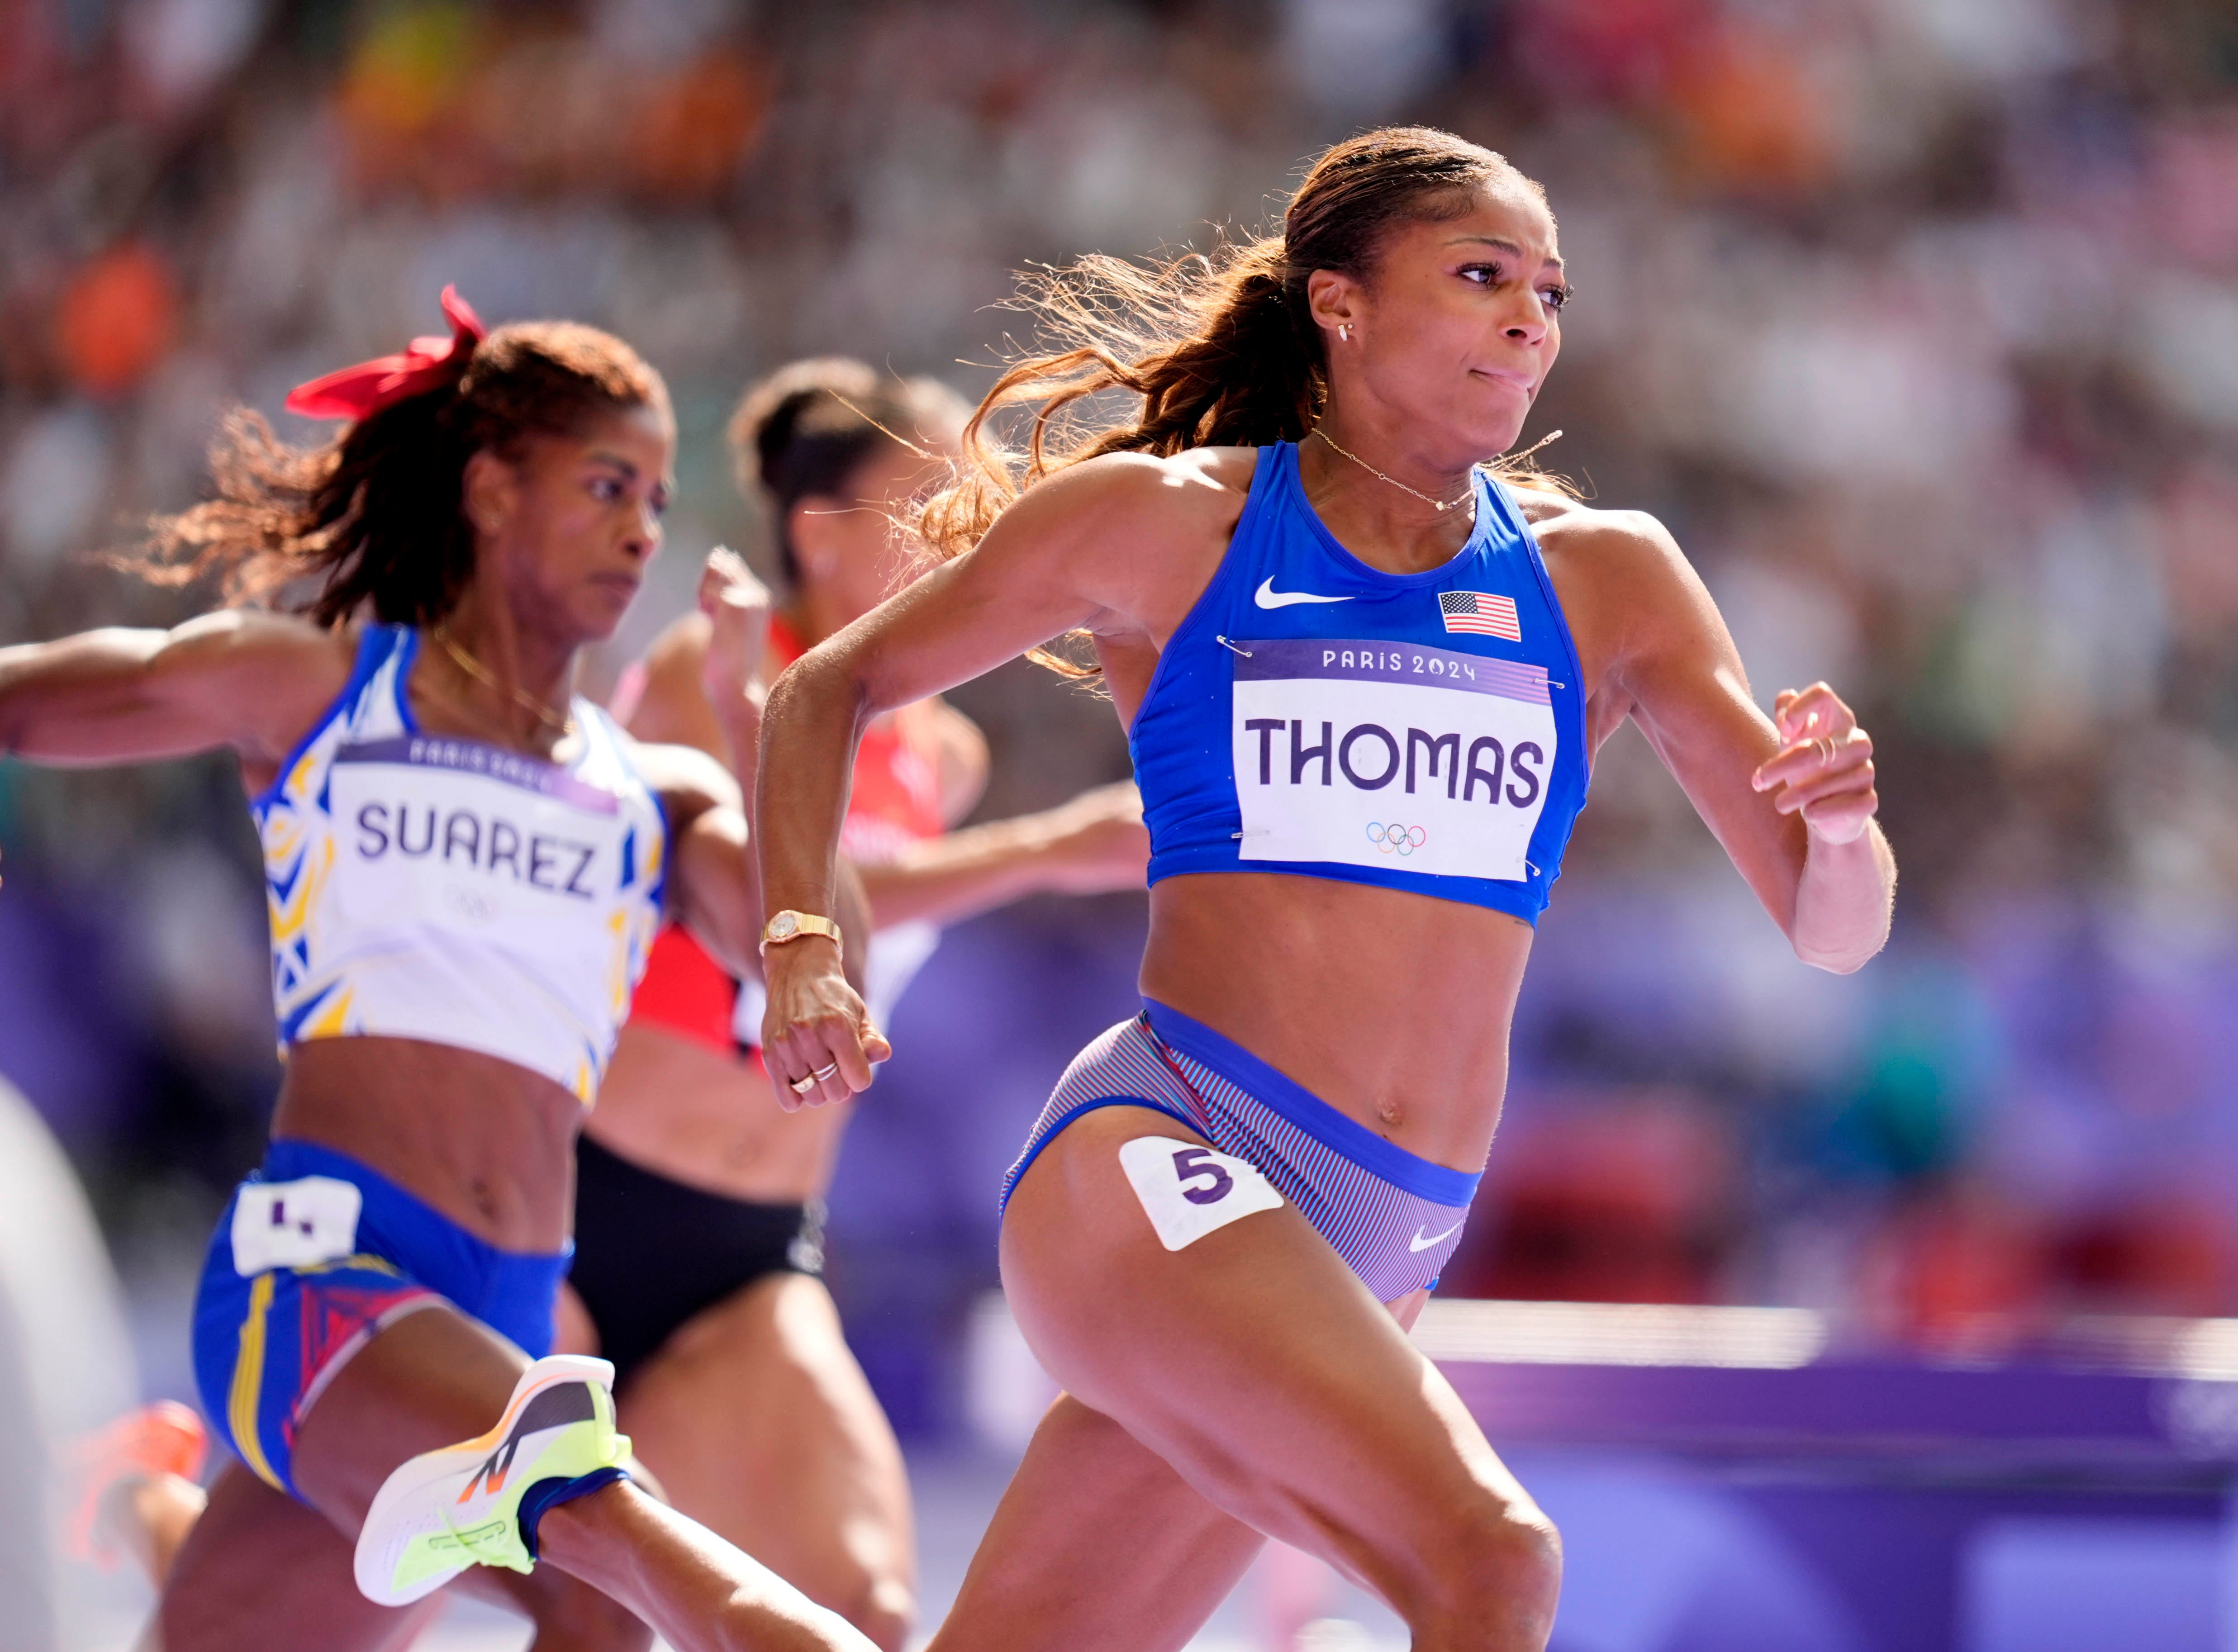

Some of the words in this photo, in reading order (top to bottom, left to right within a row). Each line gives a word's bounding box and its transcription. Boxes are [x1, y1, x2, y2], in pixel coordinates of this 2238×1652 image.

[1412, 656, 1475, 680] 2024
[1245, 718, 1544, 808] THOMAS
[357, 803, 595, 898] SUAREZ
[1172, 1149, 1233, 1204] 5
